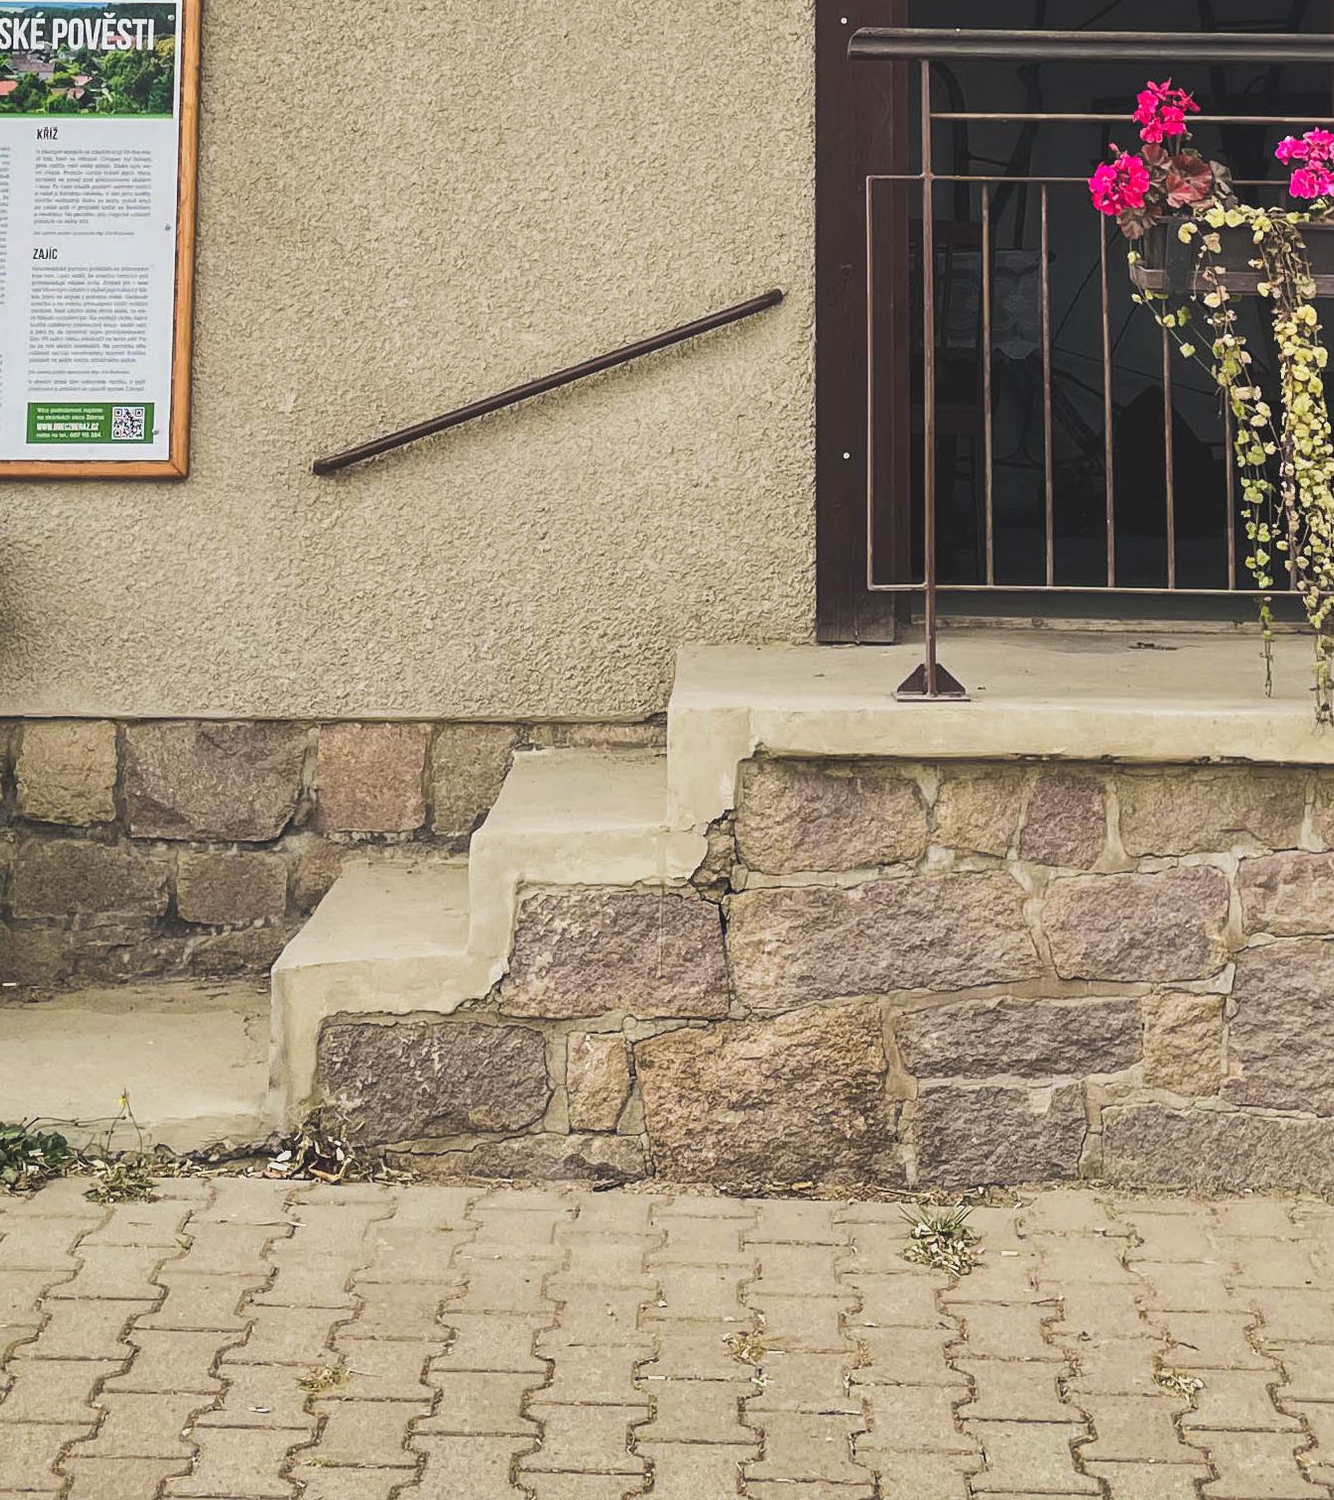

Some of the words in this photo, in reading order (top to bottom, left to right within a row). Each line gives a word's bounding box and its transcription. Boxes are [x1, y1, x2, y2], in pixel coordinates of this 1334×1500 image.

[52, 12, 155, 51] POVĚSTI
[36, 127, 58, 141] KŘÍŽ
[32, 246, 58, 260] ZAJÍC
